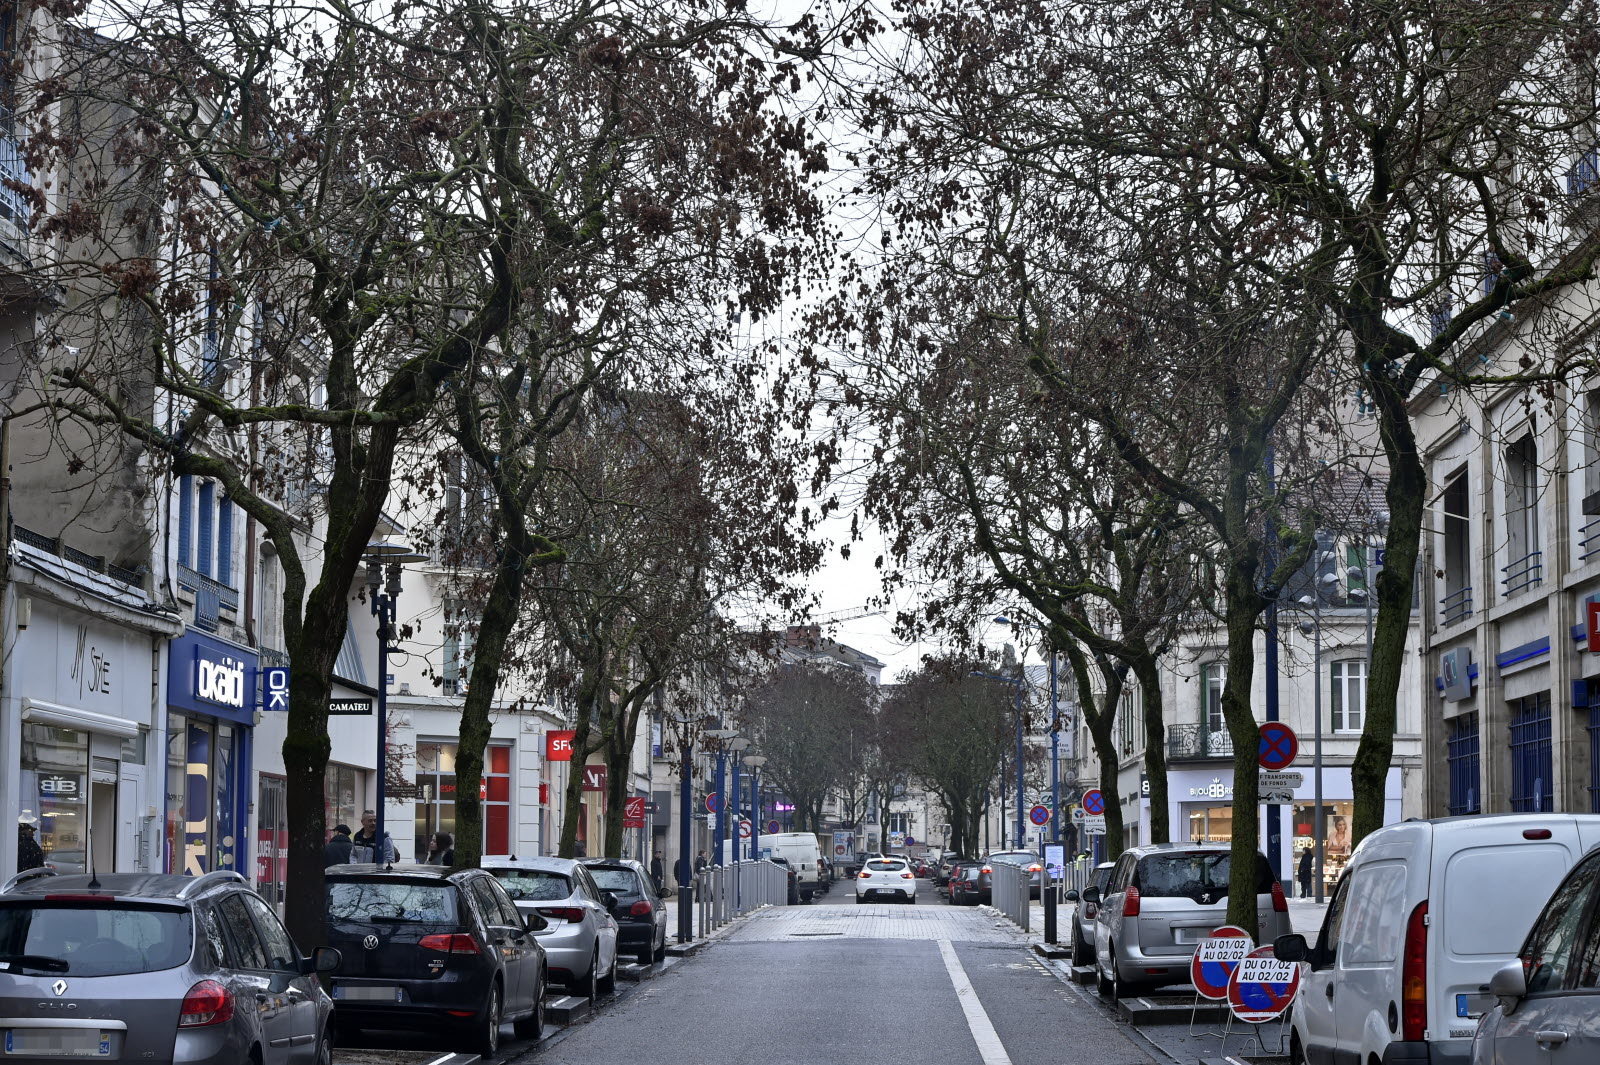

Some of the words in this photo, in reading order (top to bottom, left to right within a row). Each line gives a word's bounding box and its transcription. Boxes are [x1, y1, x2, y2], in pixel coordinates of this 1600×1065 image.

[1205, 940, 1217, 949] DU
[1218, 940, 1246, 949] 01/02
[1203, 952, 1216, 960] AU
[1217, 951, 1244, 961] 02/02
[1244, 961, 1258, 970] DU
[1260, 960, 1291, 970] 01/02
[1241, 972, 1256, 981] AU
[1257, 971, 1290, 981] 02/02
